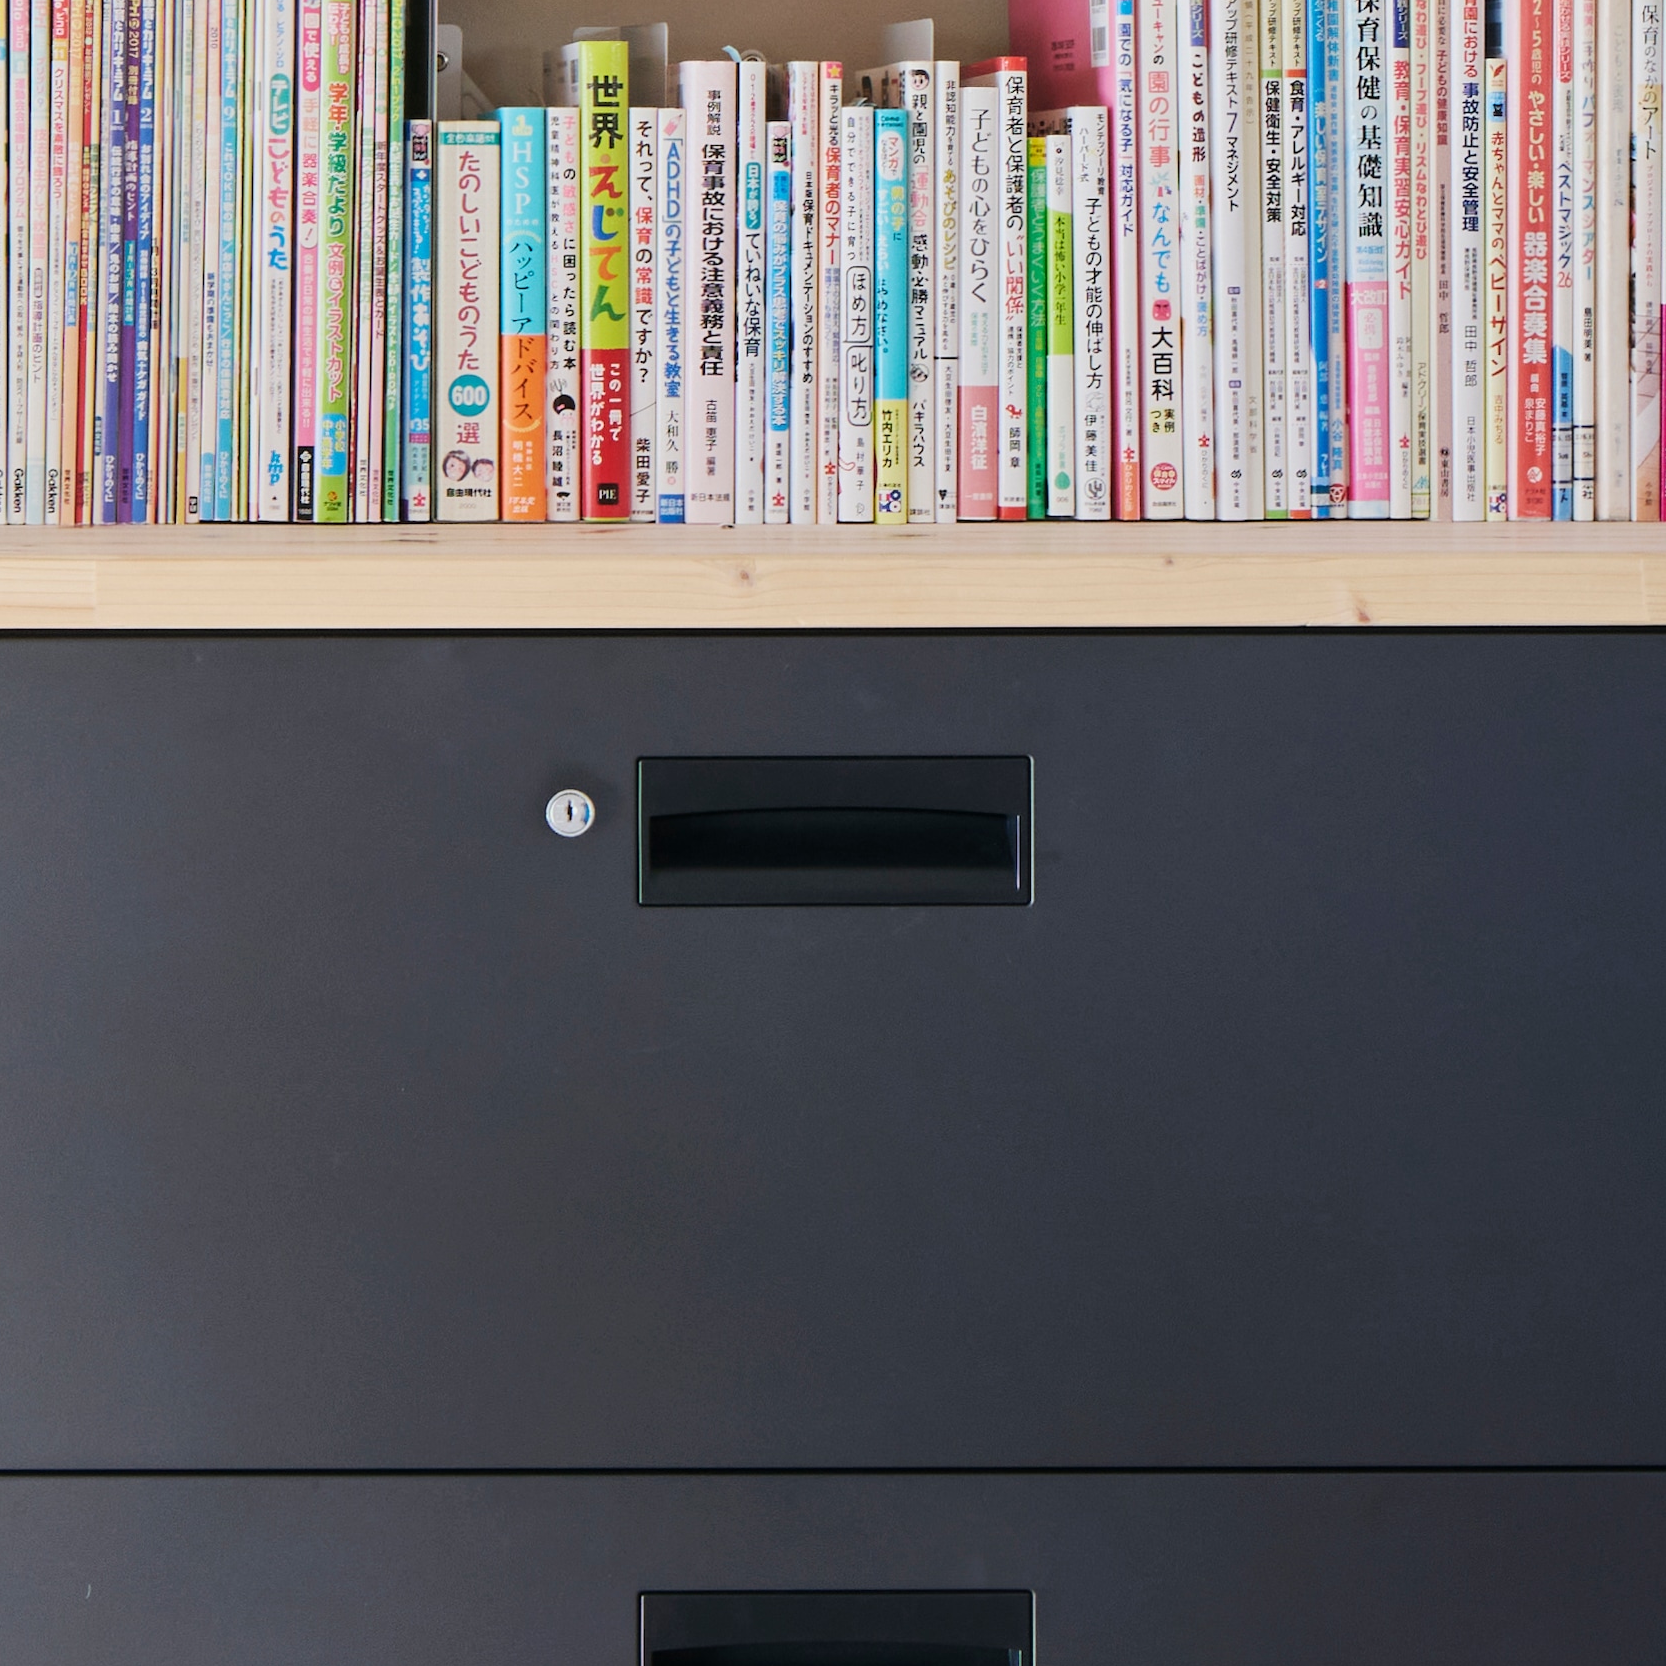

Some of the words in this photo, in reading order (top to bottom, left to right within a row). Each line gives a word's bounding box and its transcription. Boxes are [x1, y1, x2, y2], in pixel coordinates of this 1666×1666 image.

[588, 75, 624, 149] 世界
[706, 90, 721, 135] 事例解説
[1148, 71, 1171, 167] 園の行事
[1641, 5, 1659, 159] 保育のなかのアート
[268, 138, 290, 271] こどものうた
[512, 141, 533, 215] HSP
[824, 147, 841, 264] 保育者のマナー
[968, 108, 991, 303] 子どもの心をひらく
[1226, 136, 1240, 212] マネジメント
[1265, 80, 1282, 223] 保健衛生・安全対策
[1289, 80, 1306, 237] 食育・アレルギー対応
[1394, 60, 1411, 300] 教育・保育実習安心ガイド
[1462, 83, 1479, 232] 事故防止と安全管理
[458, 151, 482, 370] たのしいこどものうた
[588, 165, 626, 322] えじてん
[635, 120, 654, 383] それって、保育の常識ですか?
[699, 144, 726, 376] 保育事故における注意義務と責任
[744, 233, 762, 358] ていねいな保育
[1085, 198, 1103, 389] 子どもの才能の伸ばし方
[1150, 203, 1172, 293] なんでも
[1523, 231, 1547, 364] 器楽合奏集
[509, 241, 538, 420] ハッピーアドバイス
[851, 273, 868, 336] ほめ方
[451, 386, 487, 406] 600
[589, 364, 606, 466] 世界がわかる
[609, 363, 623, 441] この一冊で
[850, 353, 868, 420] 叱り方
[1151, 326, 1174, 401] 大百科
[456, 422, 480, 444] 選
[636, 438, 652, 503] 柴田愛子
[881, 409, 893, 468] 竹内エリカ
